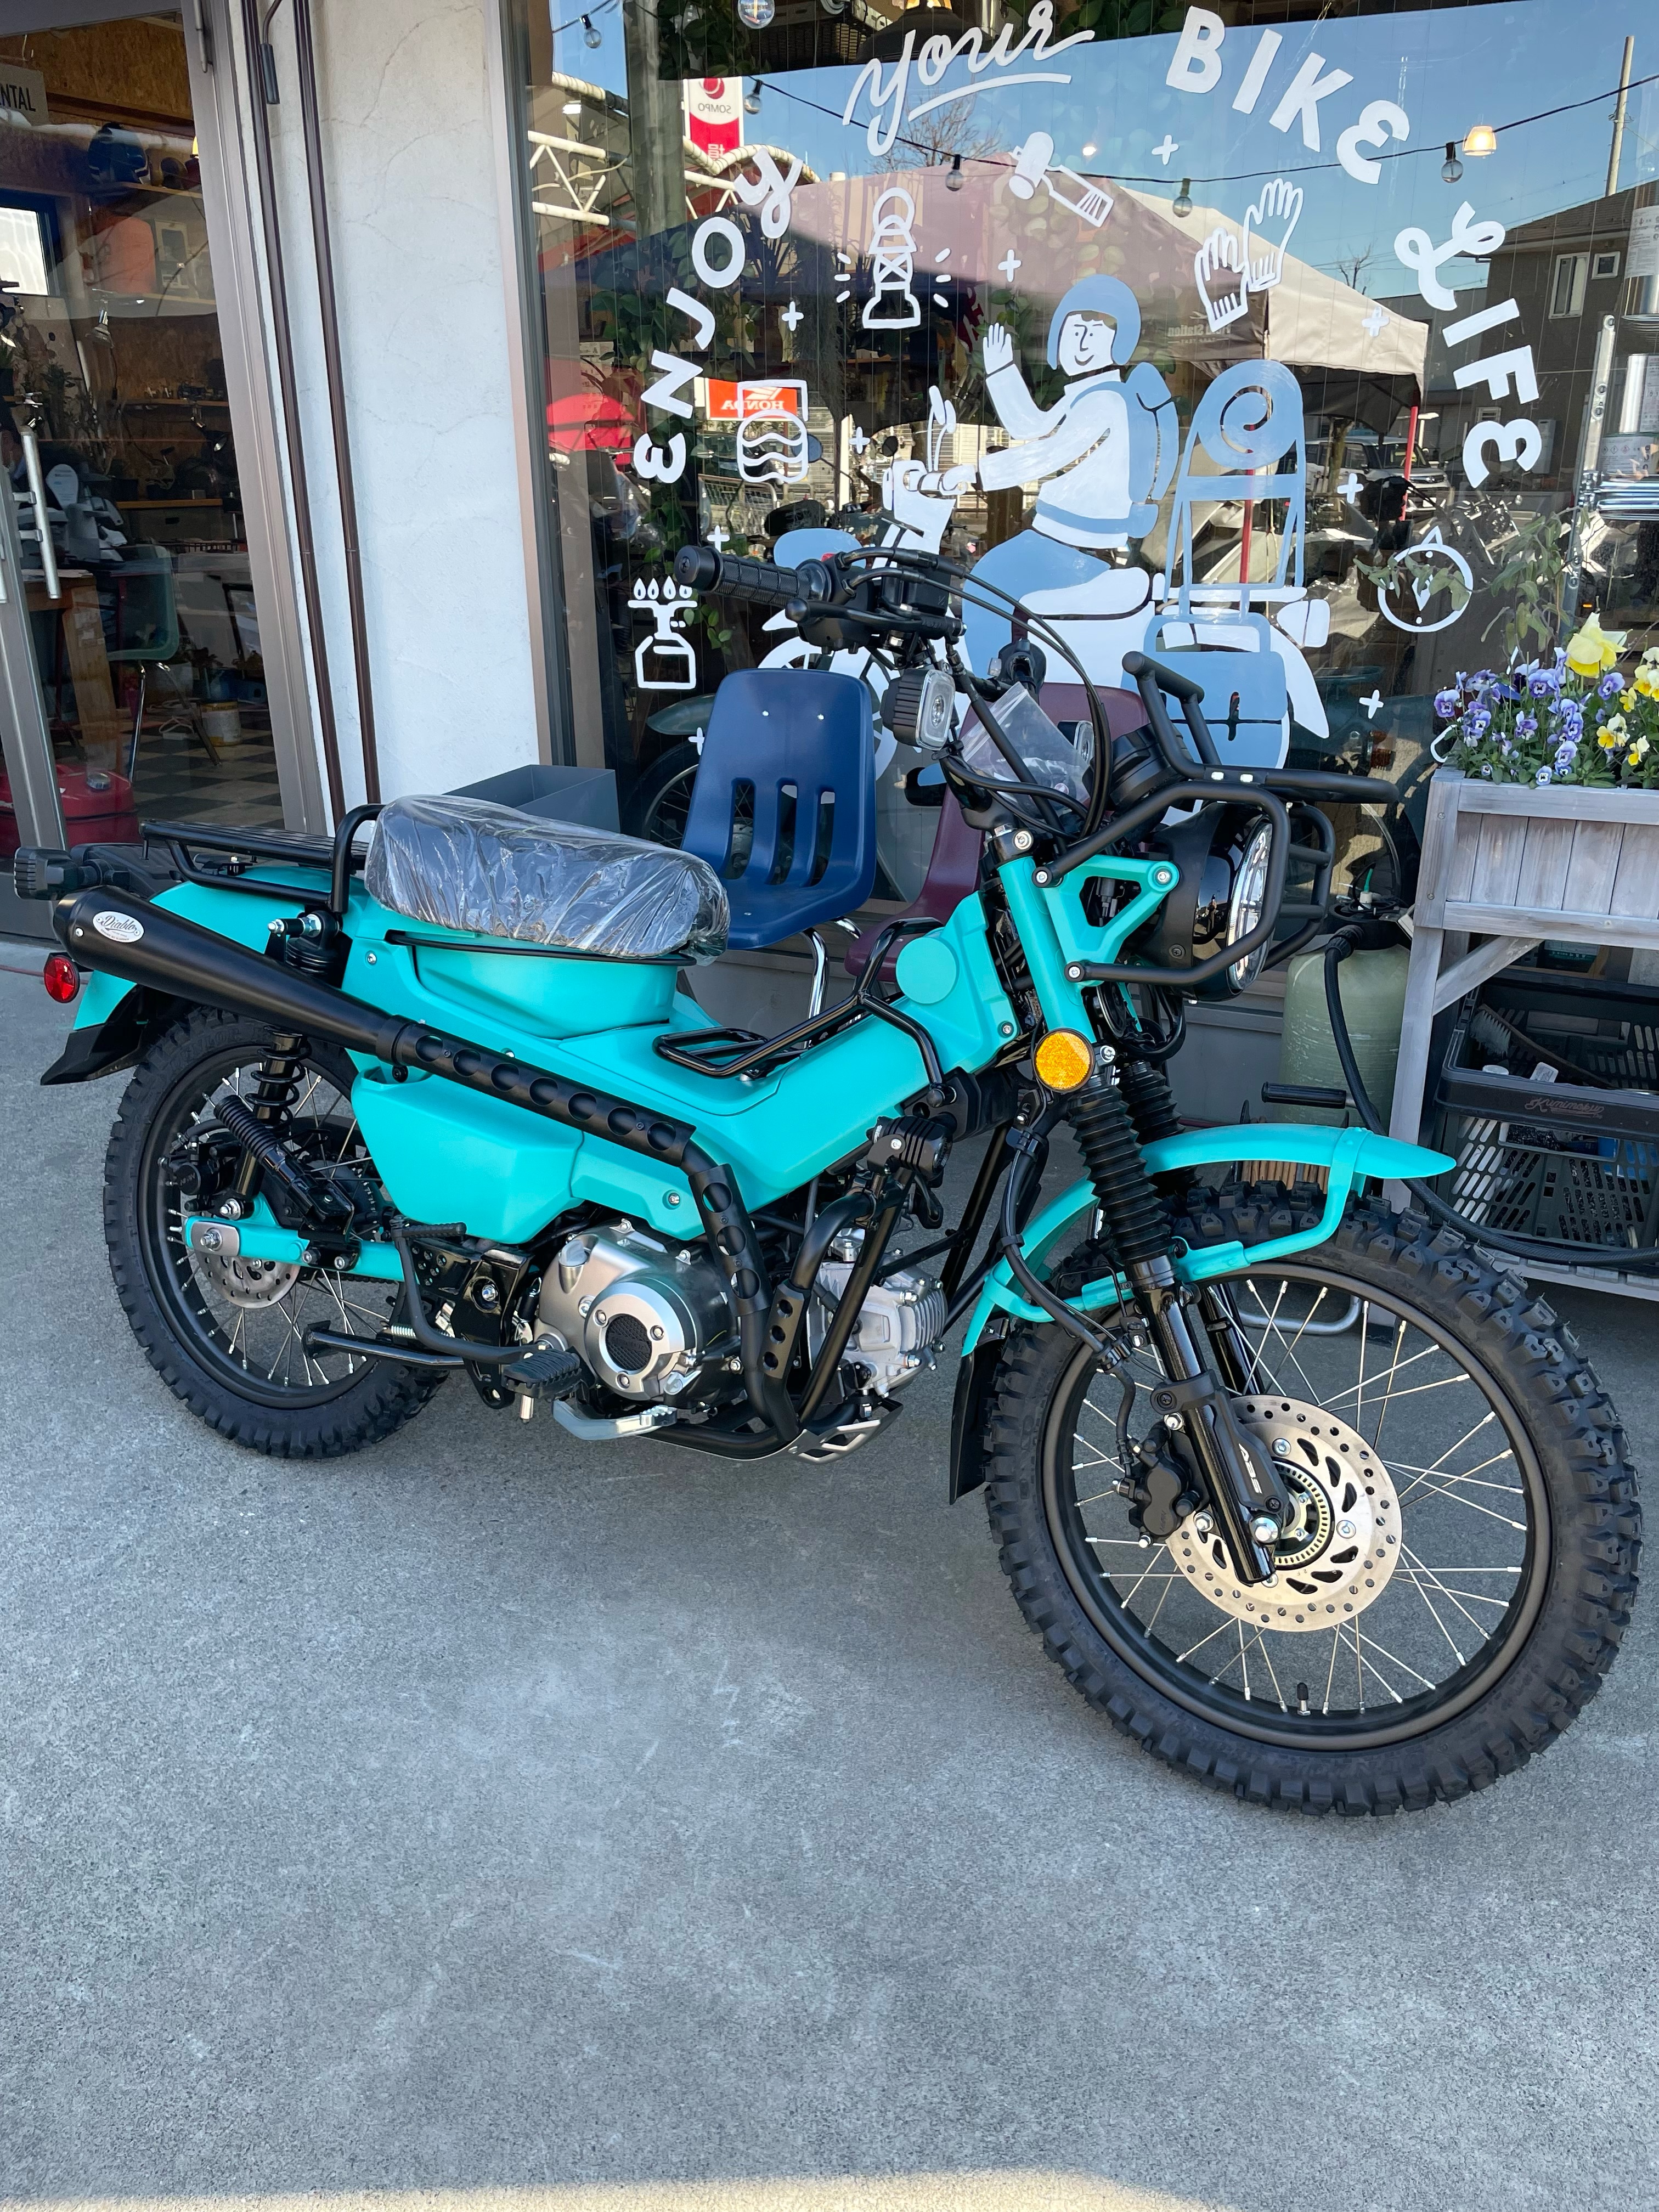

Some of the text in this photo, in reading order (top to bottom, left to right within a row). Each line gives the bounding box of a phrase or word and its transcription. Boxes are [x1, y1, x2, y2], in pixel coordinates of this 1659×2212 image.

[0, 83, 36, 112] NTAL
[843, 1, 1095, 156] your
[1166, 5, 1410, 184] BIKE
[1394, 201, 1542, 488] LIFE
[100, 915, 137, 930] Diablo
[1238, 1443, 1263, 1494] ABS
